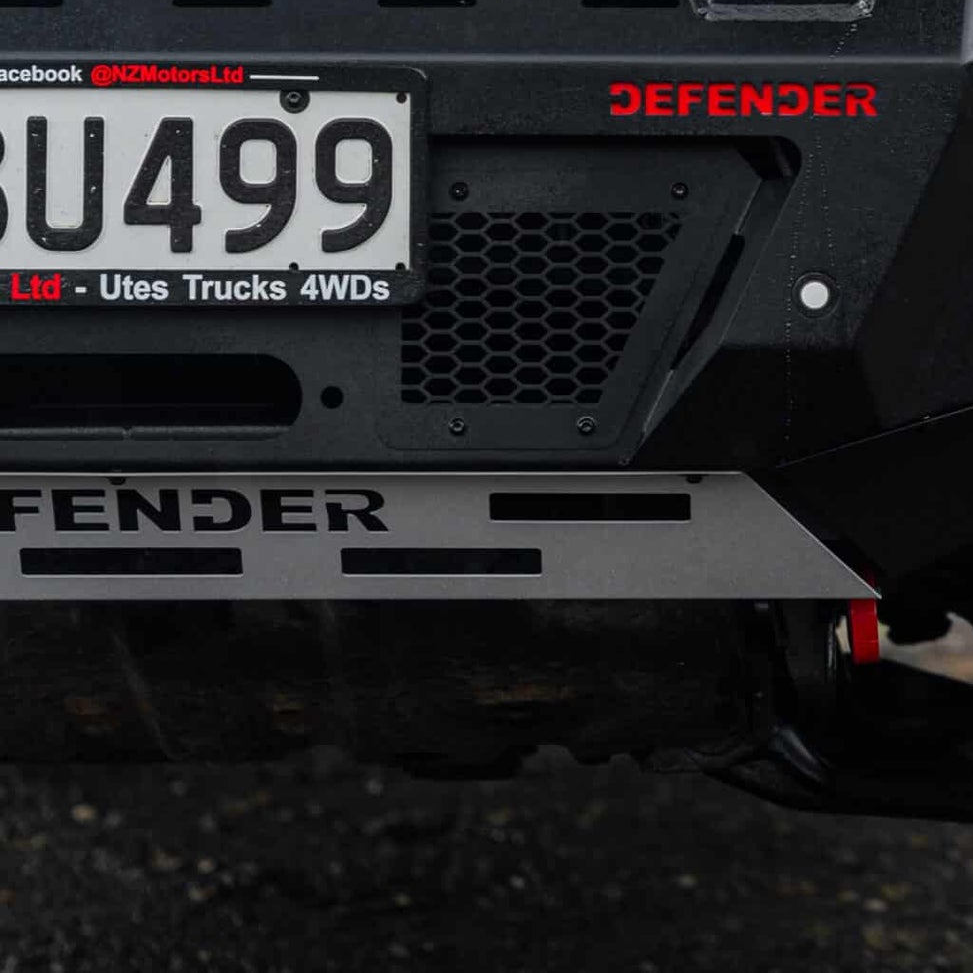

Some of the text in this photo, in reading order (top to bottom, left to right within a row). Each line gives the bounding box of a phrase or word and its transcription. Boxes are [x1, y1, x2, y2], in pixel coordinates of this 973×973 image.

[91, 64, 244, 87] @NZMotorsLtd
[609, 82, 878, 117] DEFENDER
[0, 116, 393, 253] U499
[11, 273, 61, 301] Ltd
[100, 273, 169, 301] Utes
[183, 273, 287, 301] Trucks
[300, 273, 390, 301] 4WDs
